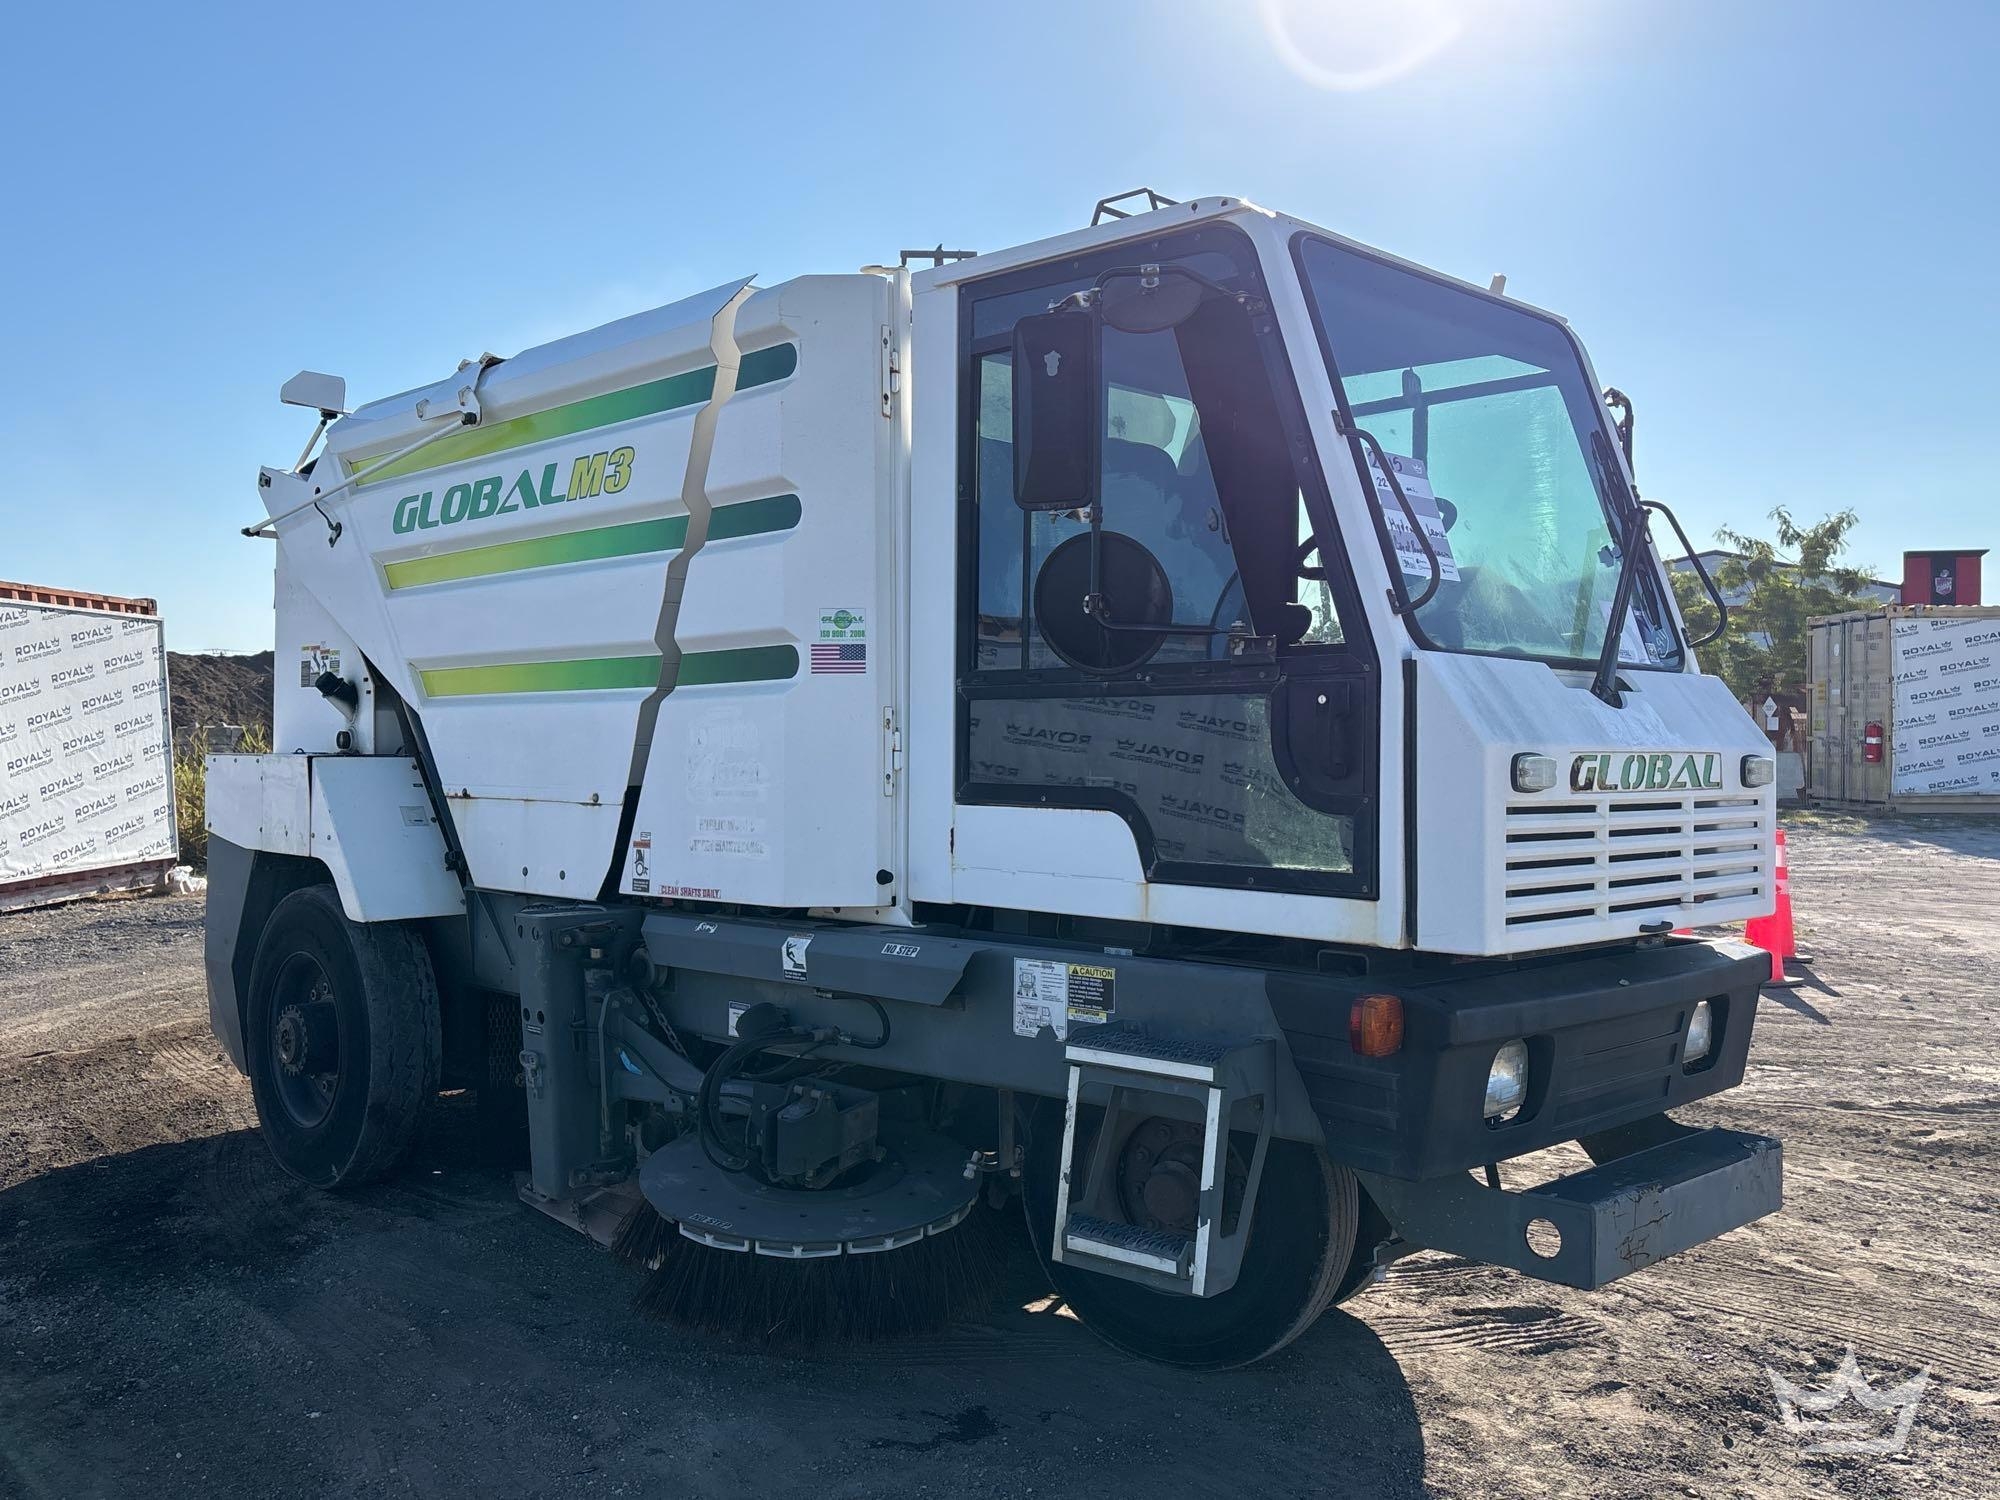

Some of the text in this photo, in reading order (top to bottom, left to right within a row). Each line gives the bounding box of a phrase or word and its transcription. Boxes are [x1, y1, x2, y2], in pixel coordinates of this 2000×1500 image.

[393, 446, 635, 534] GLOBAL M3
[71, 628, 104, 643] ROYAL
[15, 640, 51, 657] ROYAL
[1902, 643, 1941, 656] ROYAL
[104, 653, 135, 669] ROYAL
[1940, 659, 1979, 672] ROYAL
[51, 667, 85, 683] ROYAL
[82, 693, 115, 710] ROYAL
[1911, 688, 1951, 700] ROYAL
[27, 709, 62, 727] ROYAL
[1948, 704, 1988, 716] ROYAL
[115, 716, 145, 732] ROYAL
[63, 734, 96, 751] ROYAL
[1919, 733, 1959, 745] ROYAL
[7, 752, 43, 771] ROYAL
[1957, 749, 1996, 761] ROYAL
[93, 757, 125, 775] ROYAL
[1570, 754, 1721, 791] GLOBAL
[40, 776, 75, 796] ROYAL
[126, 779, 157, 796] ROYAL
[1929, 778, 1968, 789] ROYAL
[75, 800, 108, 818] ROYAL
[20, 821, 56, 842] ROYAL
[105, 821, 137, 840] ROYAL
[53, 843, 86, 863] ROYAL
[661, 885, 720, 899] CLEAN SHAFTS DAILY
[883, 944, 918, 956] NO STEP
[1080, 967, 1113, 978] CAUTION
